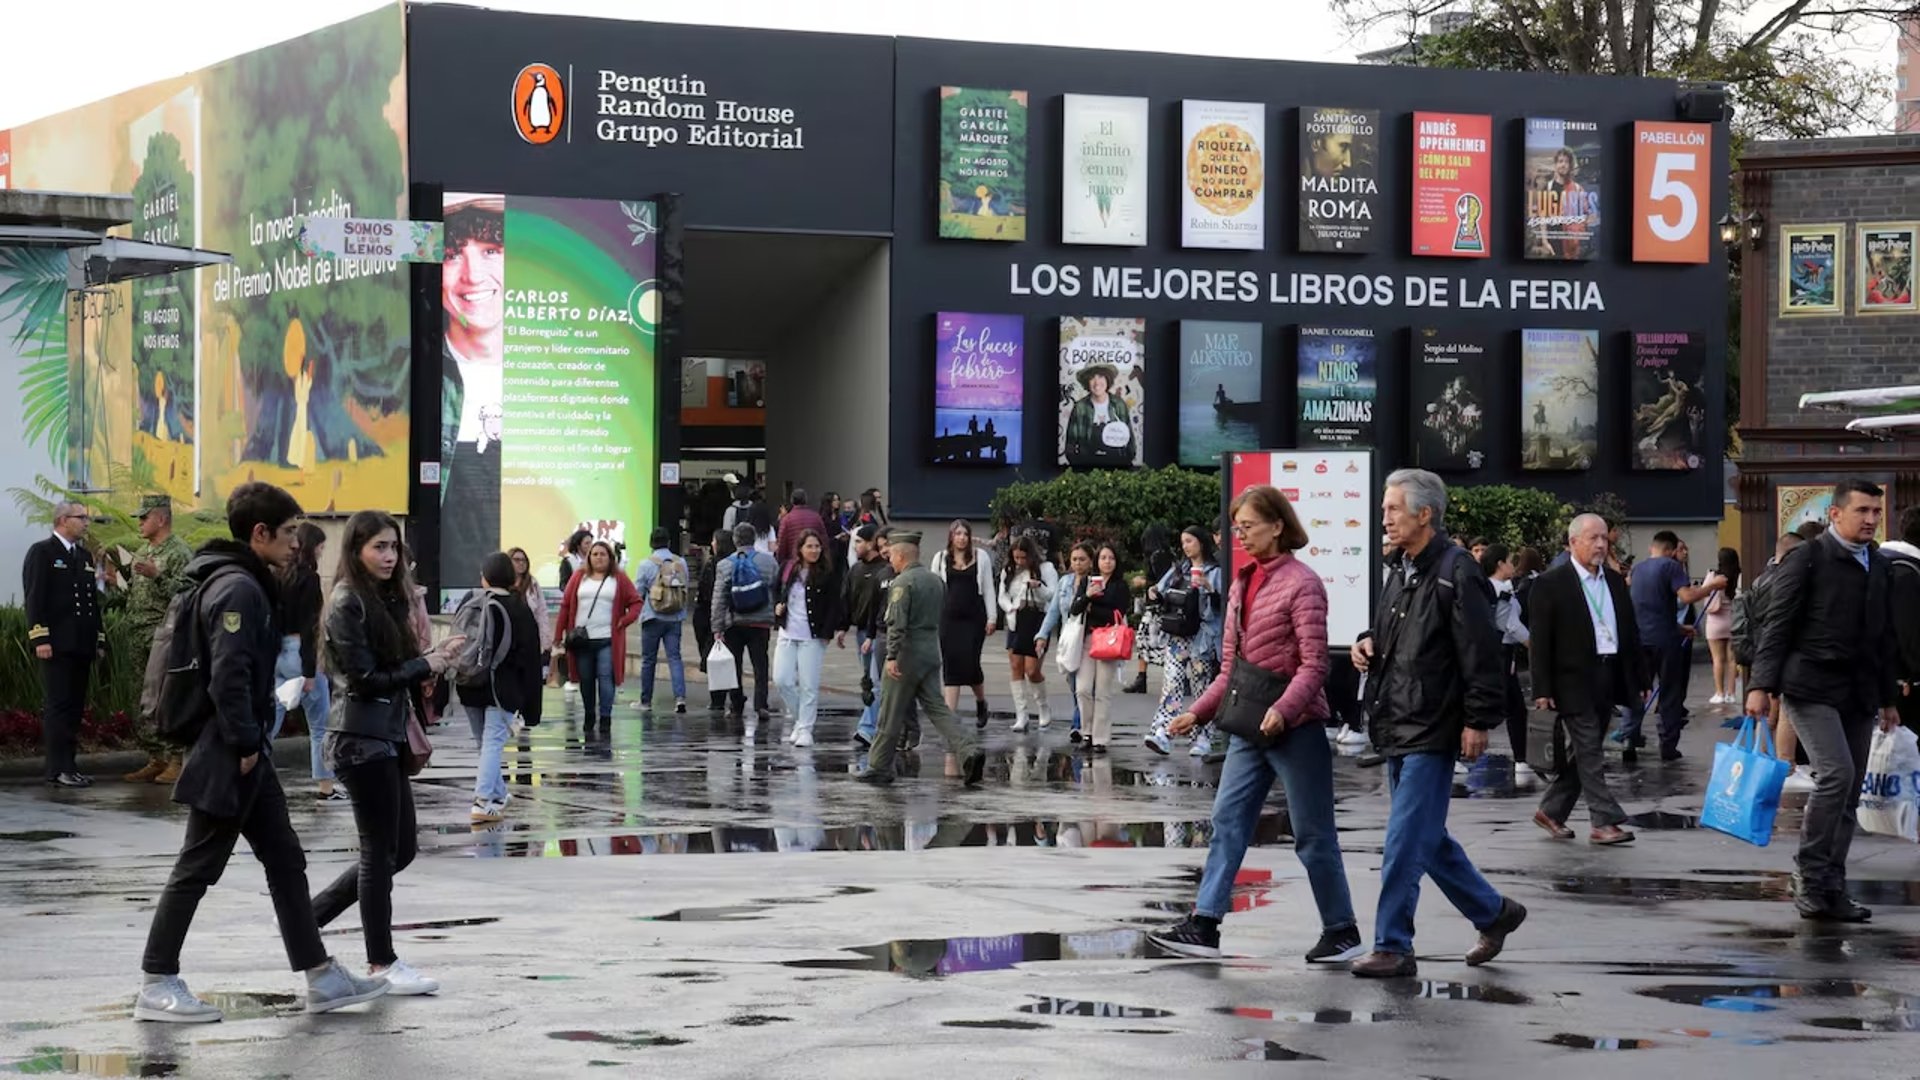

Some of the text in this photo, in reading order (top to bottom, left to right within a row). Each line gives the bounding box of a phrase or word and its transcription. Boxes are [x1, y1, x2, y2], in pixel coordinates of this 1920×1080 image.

[598, 70, 707, 98] Penguin
[598, 94, 794, 124] Random House
[960, 107, 1008, 119] GABRIEL
[960, 120, 1008, 131] GARCÍA
[1314, 113, 1367, 125] SANTIAGO
[1100, 120, 1112, 136] El
[1306, 123, 1373, 135] POSTEGUILLO
[1420, 119, 1457, 136] ANDRÉS
[1562, 121, 1597, 131] COMUNICA
[597, 120, 804, 149] Grupo Editorial
[960, 132, 1008, 144] MÁRQUEZ
[1640, 129, 1705, 145] PABELLÓN
[1082, 141, 1130, 156] infinito
[1198, 141, 1251, 152] RIQUEZA
[1420, 136, 1486, 152] OPPENHEIMER
[974, 158, 1008, 166] AGOSTO
[1209, 154, 1227, 162] QUE
[1448, 155, 1471, 168] SALIR
[960, 168, 1008, 177] NOS VEMOS
[1087, 164, 1124, 176] en un
[1201, 164, 1248, 175] DINERO
[1419, 167, 1433, 179] DEL
[1218, 178, 1246, 186] PUEDE
[1301, 175, 1378, 194] MALDITA
[1086, 181, 1124, 198] junco
[1195, 187, 1253, 199] COMPRAR
[1528, 190, 1599, 217] LUGARES
[1647, 152, 1699, 242] 5
[144, 191, 179, 220] GABRIEL
[1308, 199, 1372, 219] ROMA
[250, 213, 263, 246] La
[267, 197, 304, 241] novel
[1190, 218, 1258, 231] Robin Sharma
[144, 219, 179, 243] GARCÍA
[344, 221, 393, 236] SOMOS
[1318, 230, 1339, 238] JULIO
[1792, 240, 1834, 253] Harry Potter
[1868, 239, 1910, 252] Harry Potter
[214, 263, 230, 301] del
[234, 264, 271, 298] Premio
[275, 251, 311, 291] Nobel
[315, 255, 330, 286] de
[1010, 263, 1605, 311] LOS MEJORES LIBROS DE LA FERIA
[504, 289, 568, 304] CARLOS
[153, 308, 179, 324] AGOSTO
[504, 306, 633, 325] ALBERTO DÍAZ,
[574, 329, 584, 337] es
[586, 329, 598, 338] un
[1302, 328, 1374, 337] DANIEL CORONELL
[1636, 333, 1689, 344] WILLIAM OSPINA
[144, 334, 179, 349] NOS VEMOS
[952, 326, 1017, 357] Las luces
[1204, 332, 1239, 350] MAR
[504, 344, 542, 355] granjero
[574, 345, 630, 356] comunitario
[1331, 344, 1345, 356] LOS
[1424, 343, 1483, 355] Sergio del Molino
[1072, 349, 1132, 364] BORREGO
[1190, 349, 1253, 367] ADENTRO
[557, 361, 592, 371] creador
[594, 362, 606, 371] de
[948, 352, 1016, 389] febrero
[504, 377, 549, 387] contenido
[551, 379, 573, 388] para
[1331, 385, 1344, 397] DEL
[600, 394, 630, 405] donde
[557, 411, 593, 420] cuidado
[1303, 400, 1372, 422] AMAZONAS
